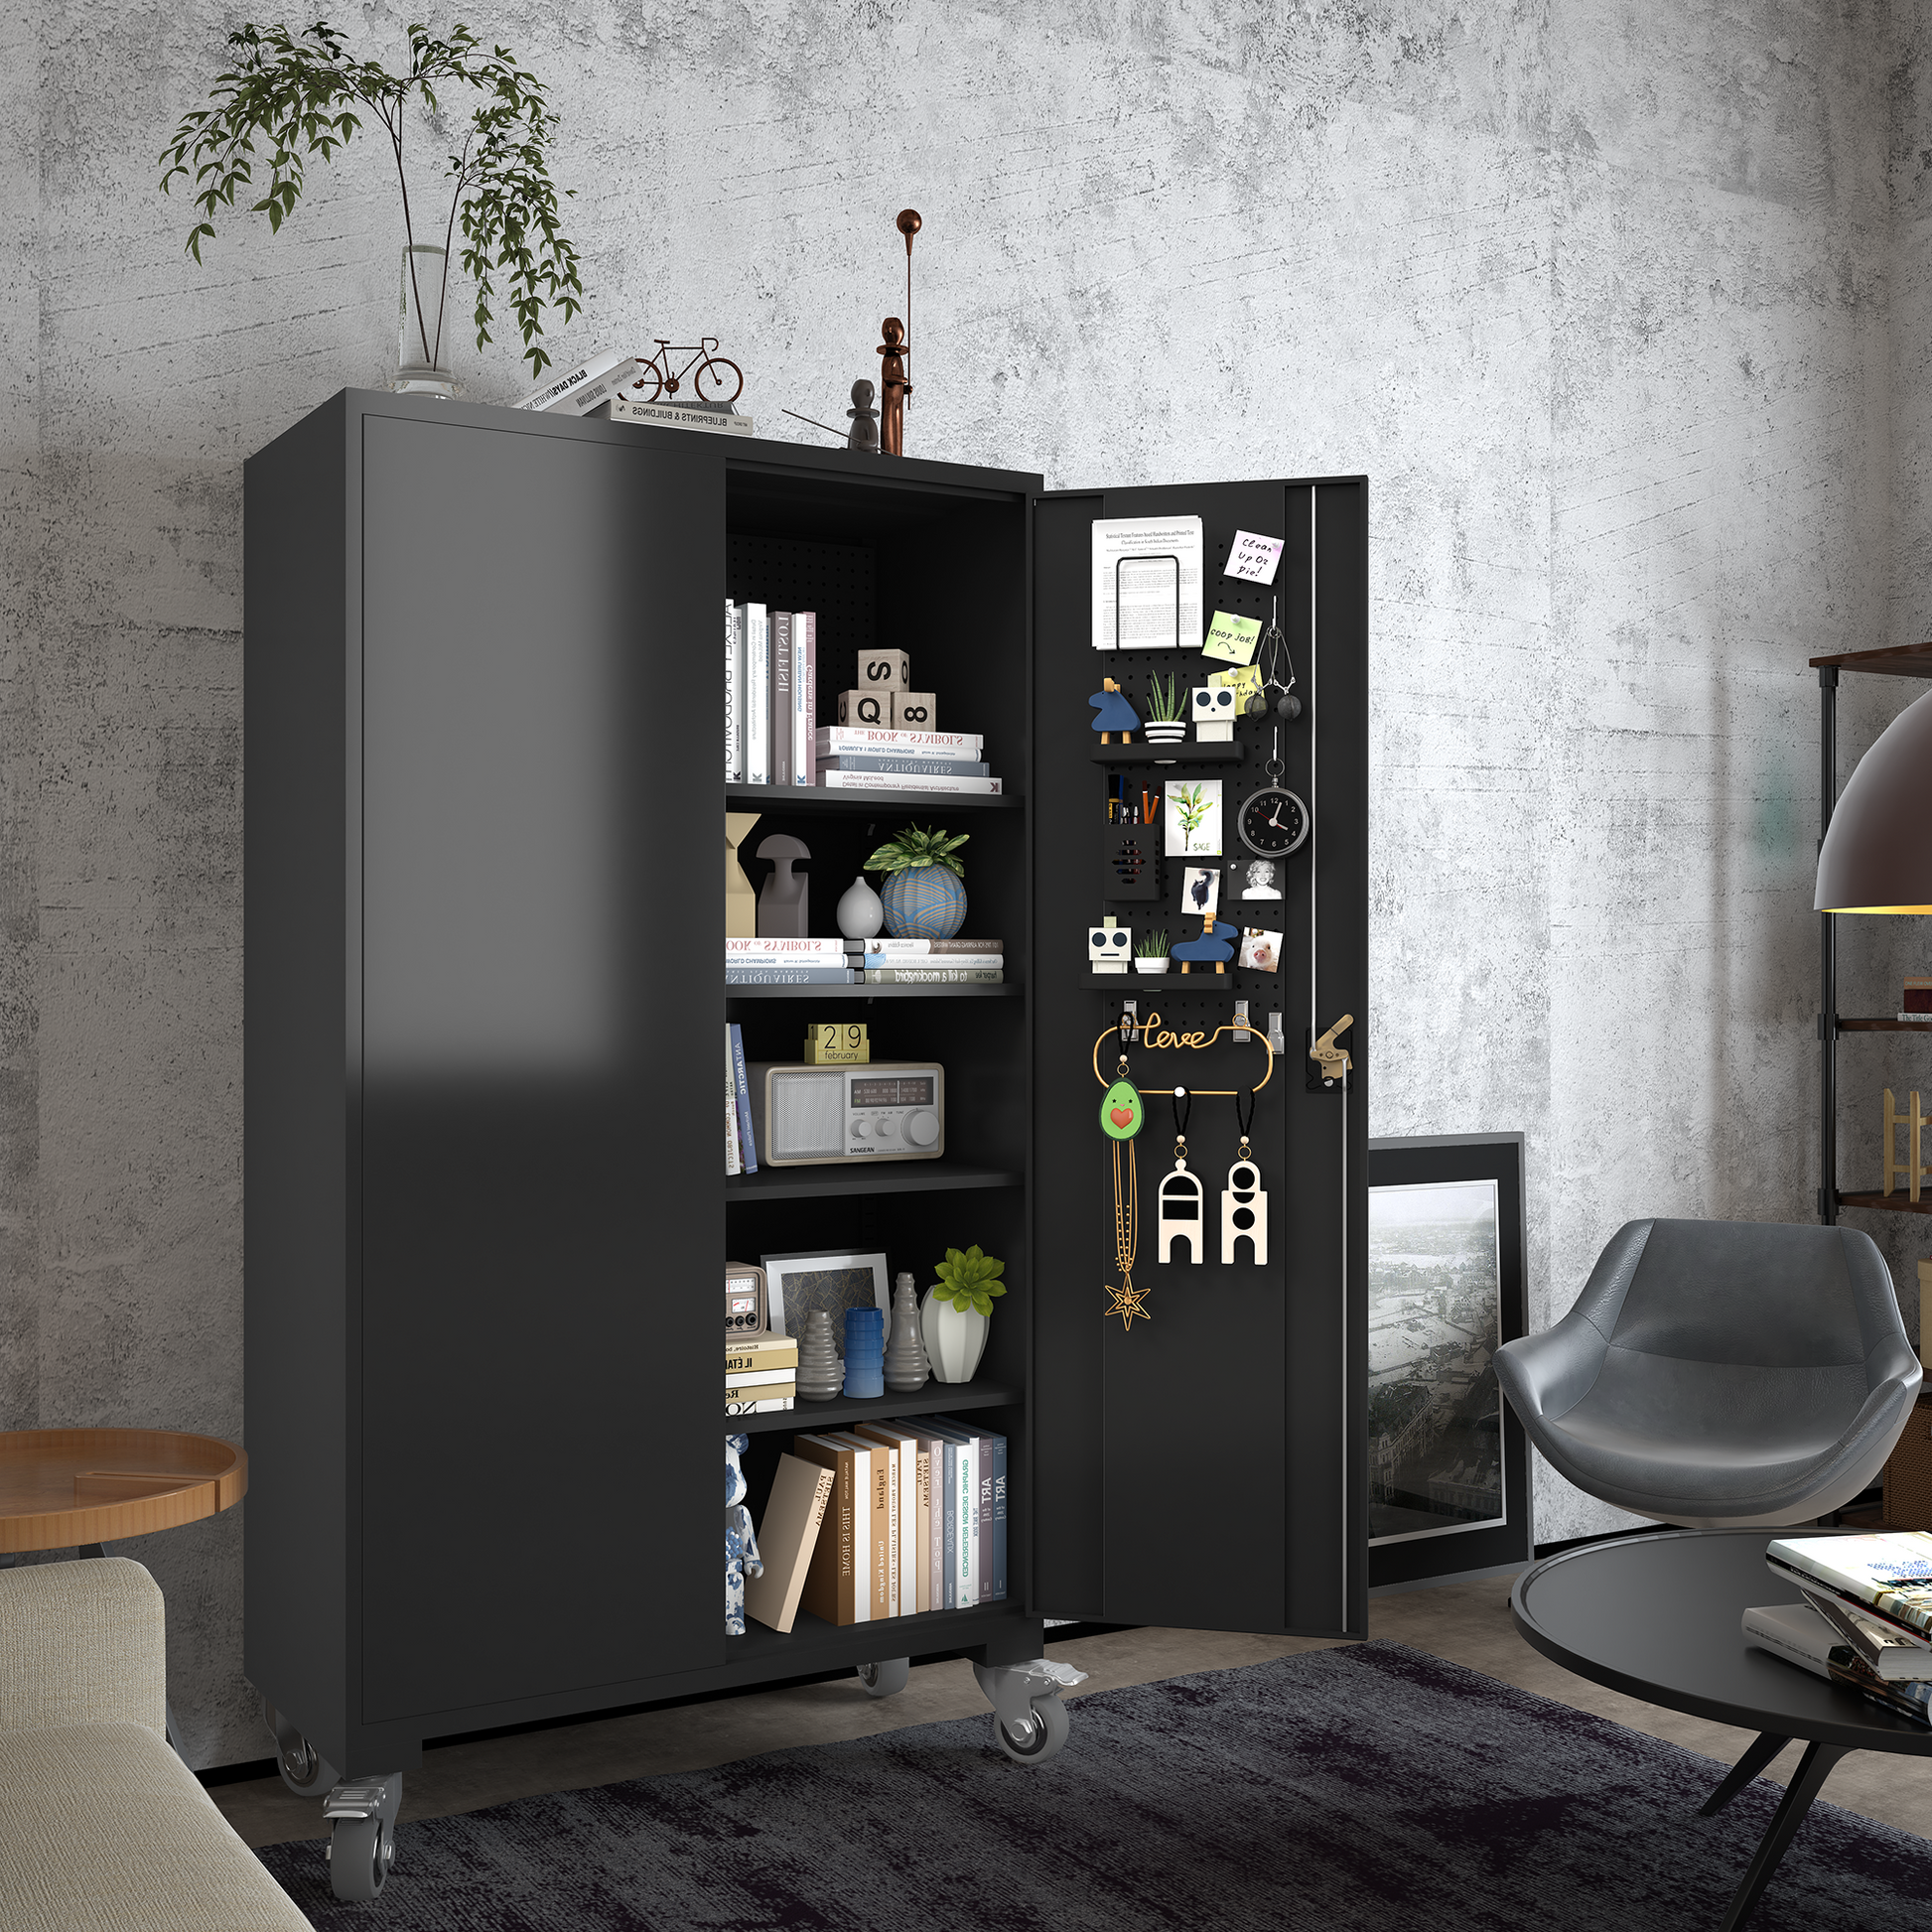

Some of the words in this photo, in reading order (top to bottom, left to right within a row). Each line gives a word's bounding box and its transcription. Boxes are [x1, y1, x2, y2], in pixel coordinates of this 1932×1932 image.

[1242, 539, 1272, 552] Clean
[867, 662, 891, 681] S
[857, 697, 881, 725] Q
[904, 707, 928, 723] 8
[1193, 842, 1211, 851] SAGE
[825, 1050, 858, 1061] february
